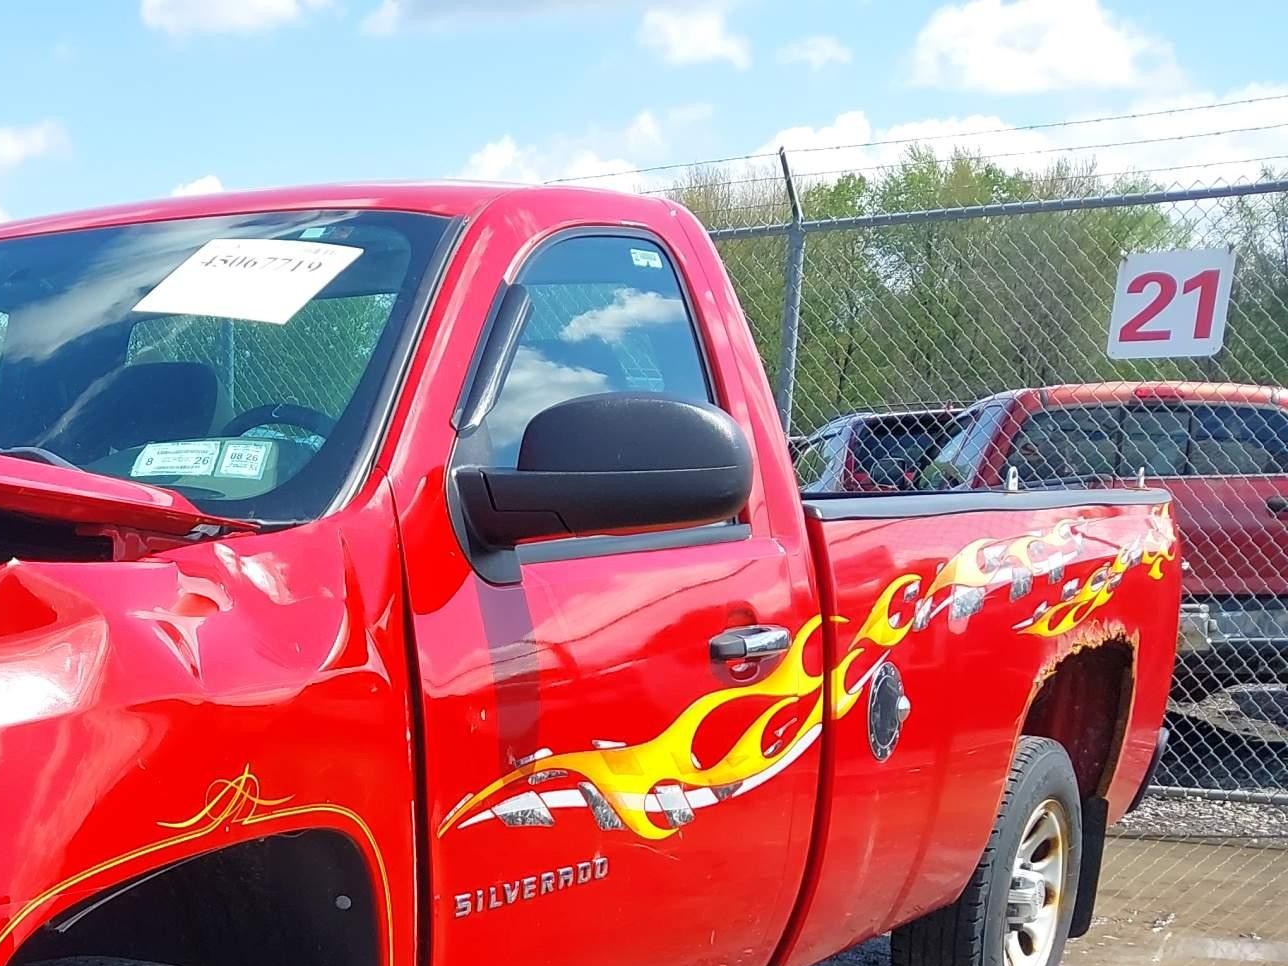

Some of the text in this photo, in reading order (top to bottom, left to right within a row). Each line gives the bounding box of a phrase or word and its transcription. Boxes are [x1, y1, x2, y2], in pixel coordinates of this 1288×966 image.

[1118, 269, 1220, 343] 21
[193, 456, 210, 465] 26
[246, 453, 258, 462] 26
[455, 856, 609, 918] SILVERADO
